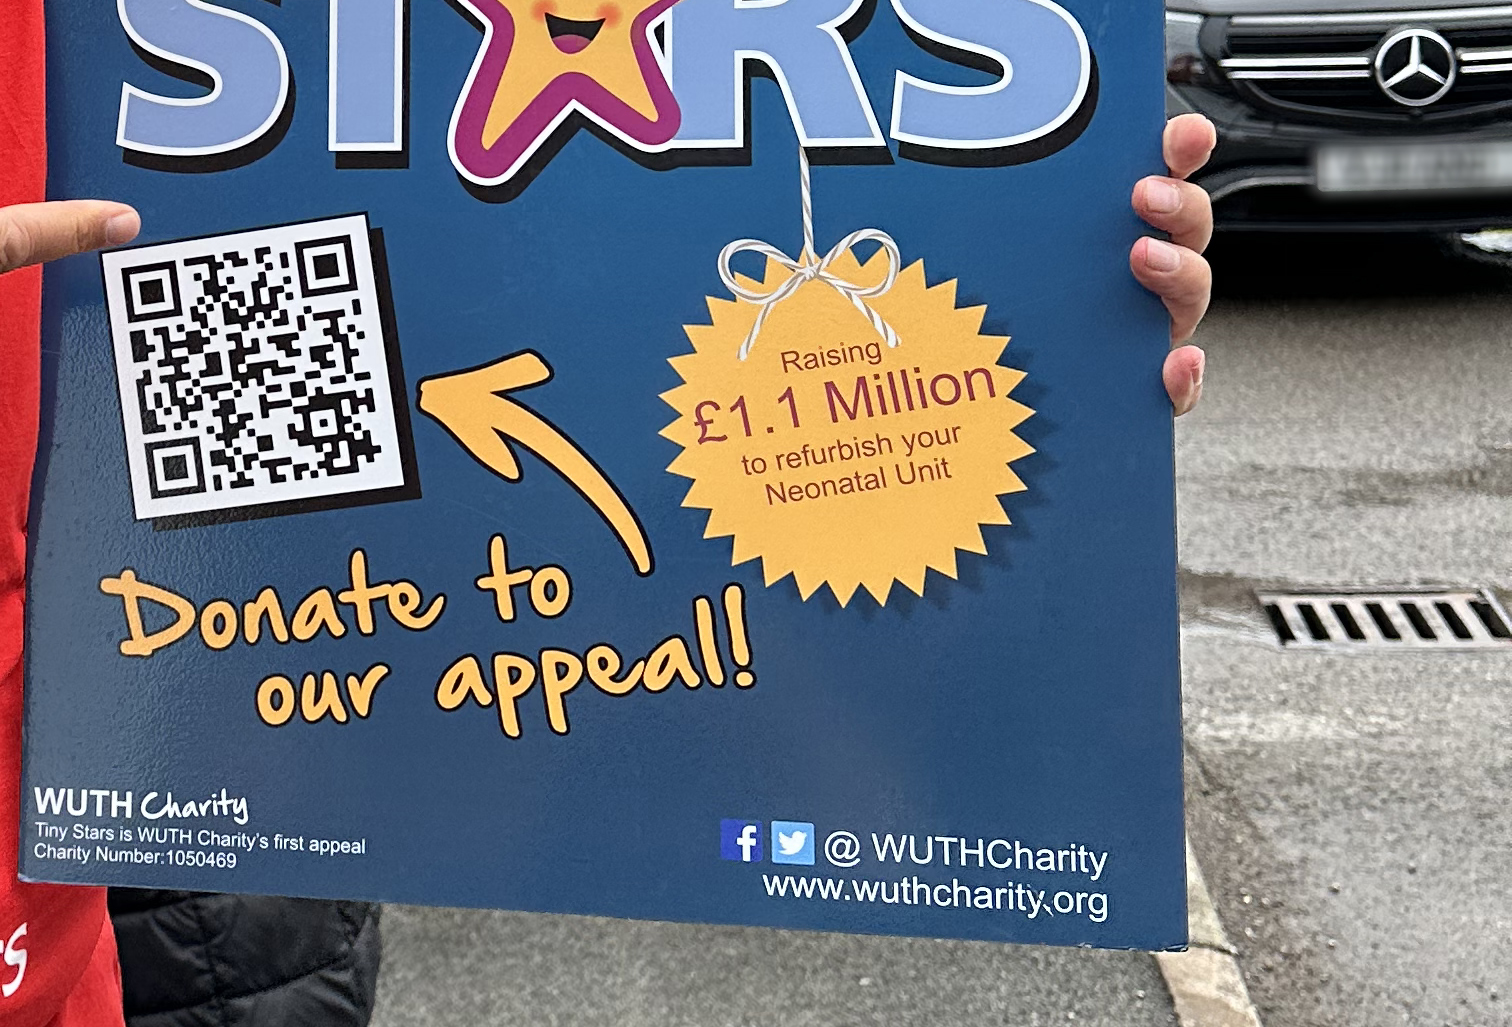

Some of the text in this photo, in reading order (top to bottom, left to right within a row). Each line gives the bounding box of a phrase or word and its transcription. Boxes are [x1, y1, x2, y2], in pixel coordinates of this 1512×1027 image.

[780, 341, 883, 374] Raising
[693, 366, 997, 446] £1.1 Million
[741, 425, 962, 476] to refurbish your
[764, 457, 953, 506] Neonatal Unit
[99, 533, 572, 657] Donate to
[255, 583, 756, 738] our appeal!
[33, 786, 249, 825] WUTH Charity
[34, 821, 366, 857] Tiny Stars is WUTH Charity's first appeal
[34, 842, 91, 861] Charity
[871, 831, 1109, 880] WUTHCharity
[761, 873, 1109, 923] www.wuthcharity.org
